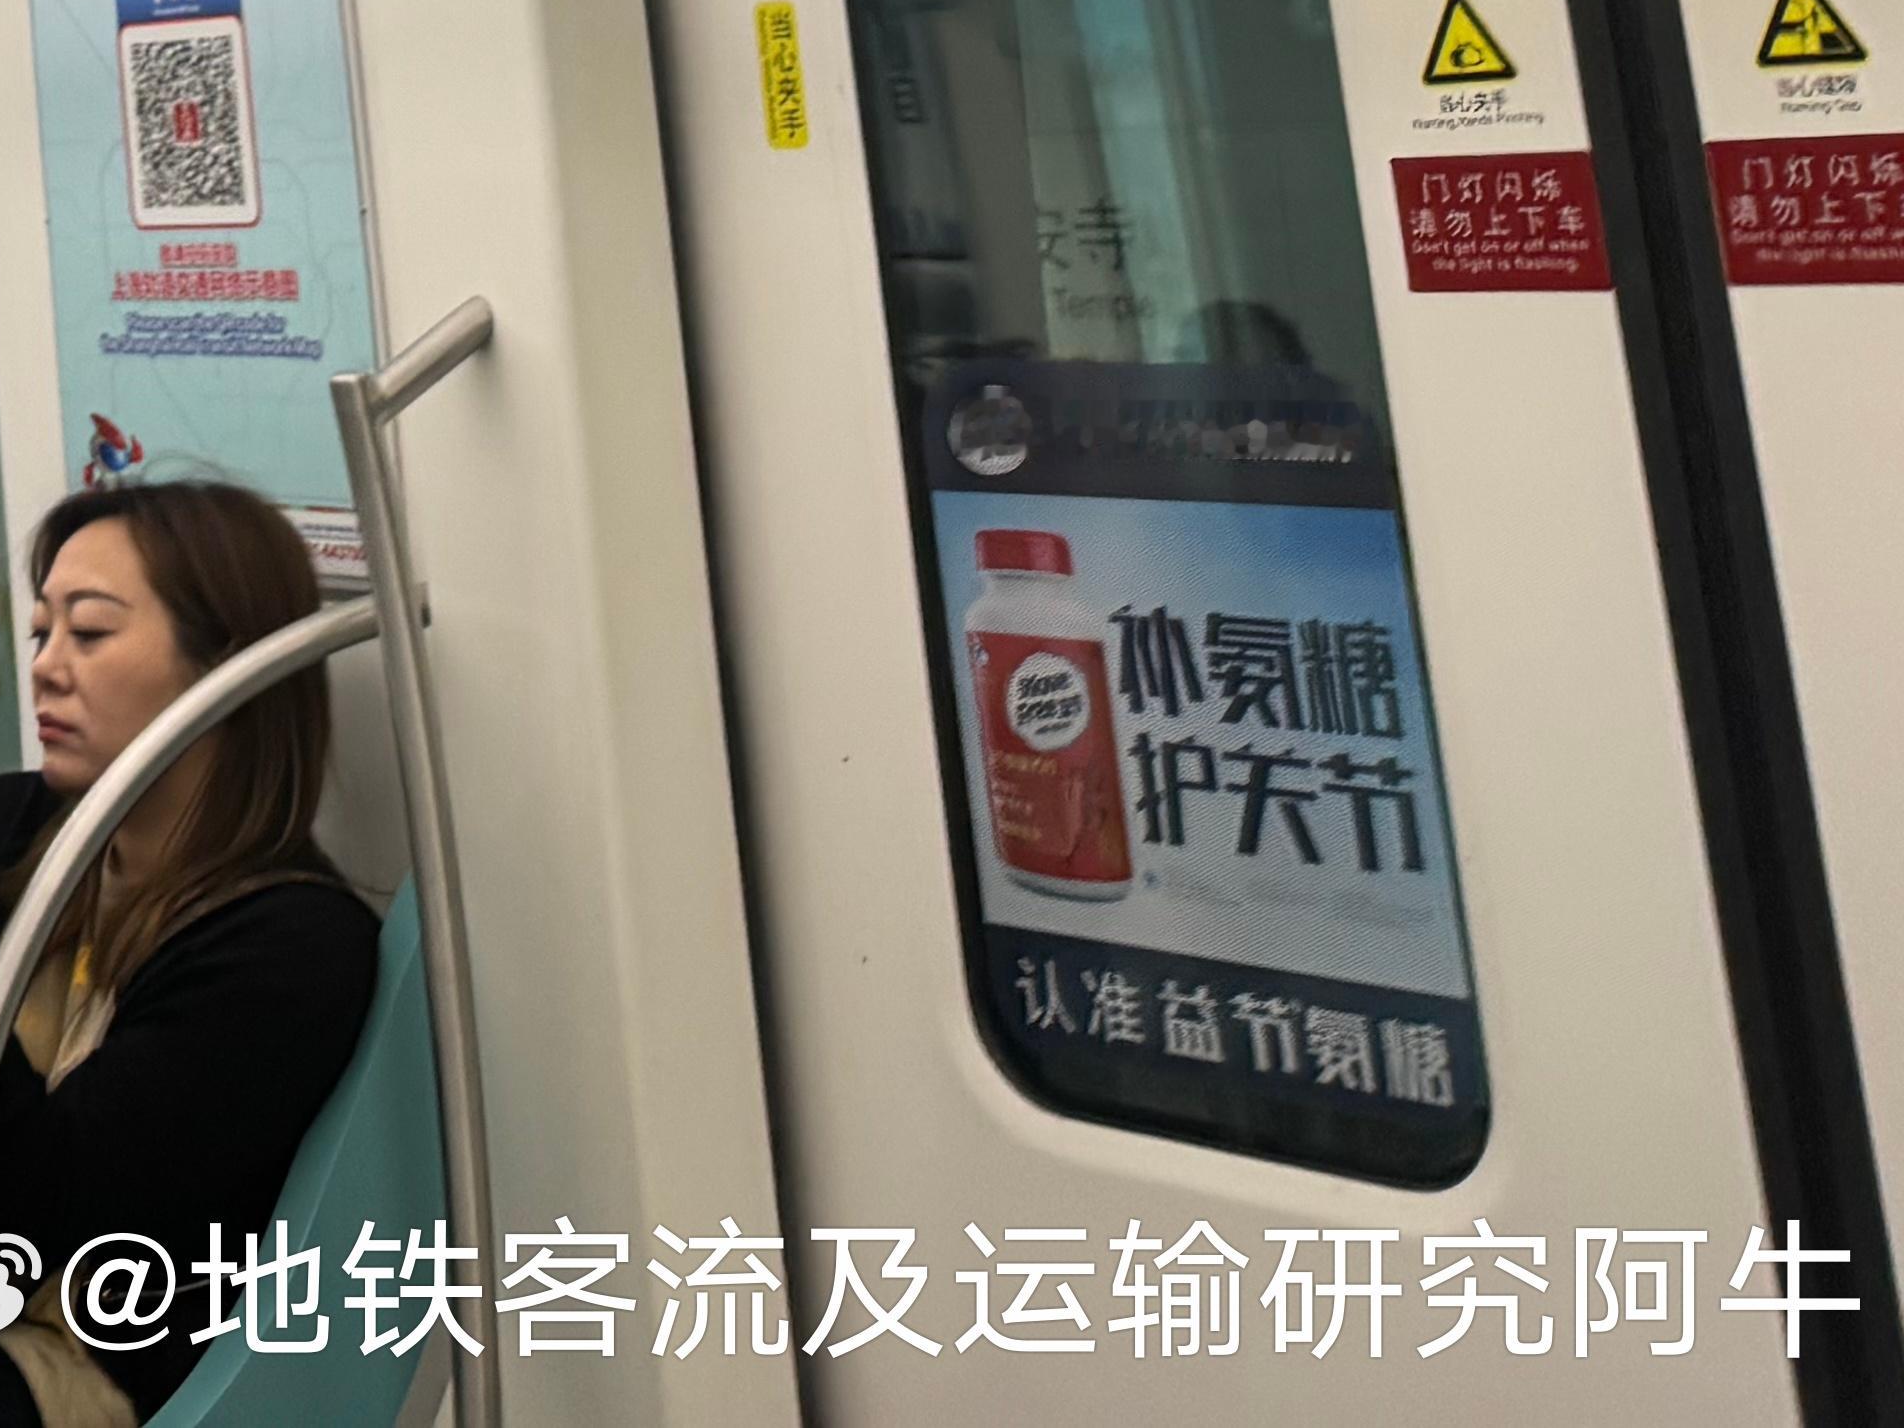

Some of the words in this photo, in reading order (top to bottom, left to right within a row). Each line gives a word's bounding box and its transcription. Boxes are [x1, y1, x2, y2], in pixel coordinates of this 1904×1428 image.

[1421, 167, 1562, 205] 门灯闪烁
[1742, 151, 1904, 189] 门灯闪烁
[1409, 204, 1587, 239] 请勿上下车
[1729, 190, 1904, 229] 请勿上下
[1128, 731, 1428, 873] 护关节
